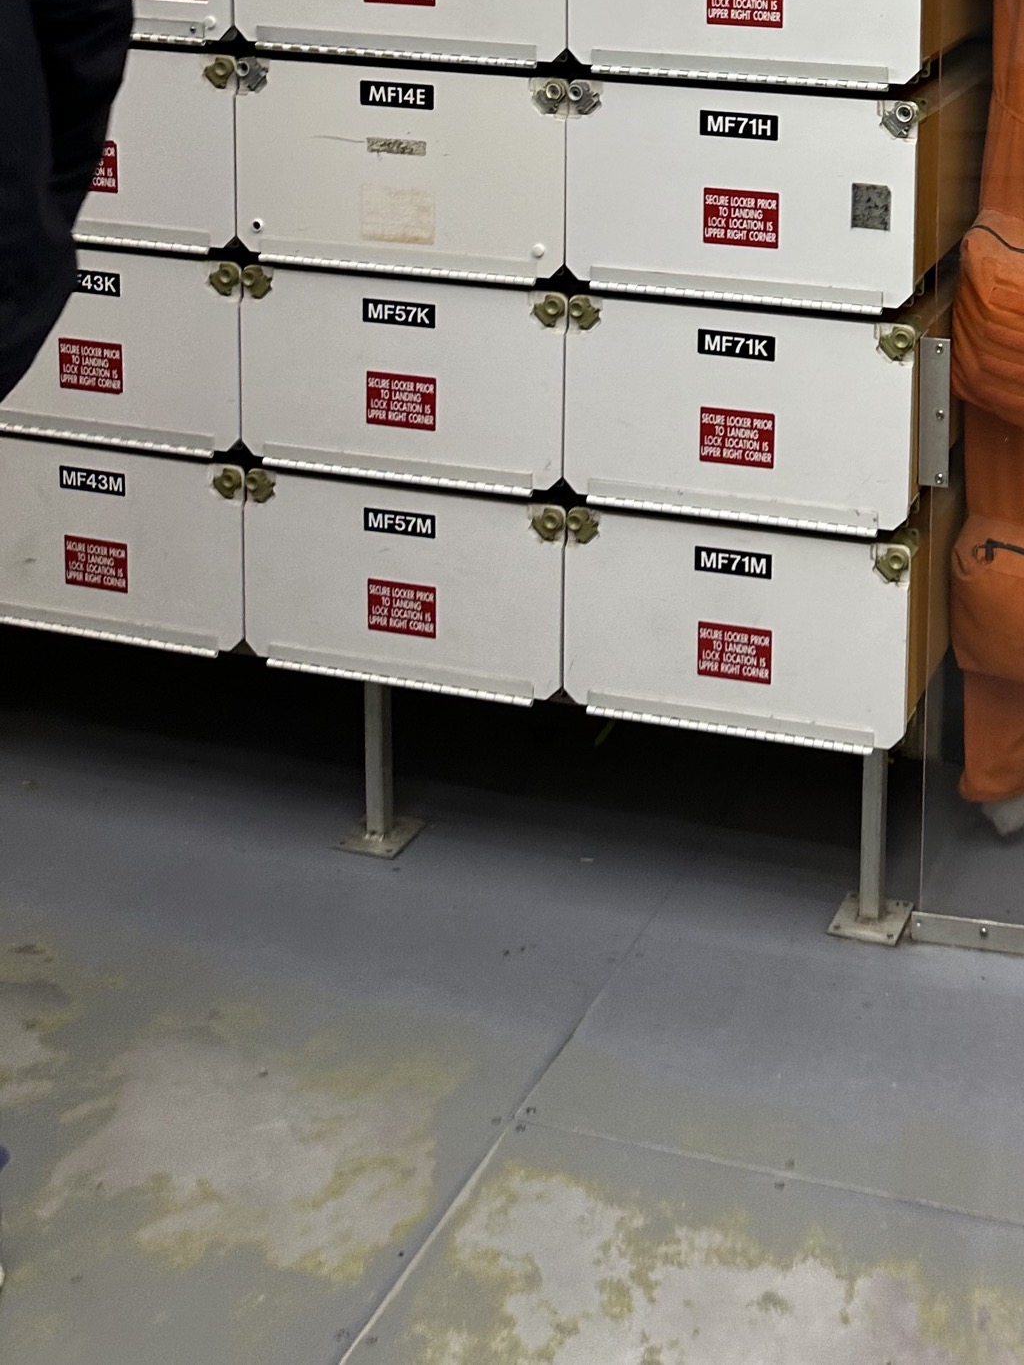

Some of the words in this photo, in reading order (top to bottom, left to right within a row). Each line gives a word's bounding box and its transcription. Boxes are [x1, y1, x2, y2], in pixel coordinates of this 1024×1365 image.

[770, 0, 777, 10] IS
[708, 8, 728, 18] UPPER
[730, 9, 751, 20] RIGHT
[753, 10, 780, 21] CORNER
[368, 85, 426, 105] MF14E
[707, 115, 772, 137] MF71H
[705, 194, 728, 205] SECURE
[730, 196, 755, 207] LOCKER
[757, 198, 776, 209] PRIOR
[718, 206, 728, 216] TO
[731, 207, 762, 219] LANDING
[707, 216, 726, 227] LOCK
[729, 218, 764, 230] LOCATION
[766, 221, 773, 231] IS
[704, 227, 724, 238] UPPER
[727, 229, 747, 240] RIGHT
[749, 231, 776, 242] CORNER
[368, 302, 430, 324] MF57K
[704, 334, 768, 357] MF71K
[701, 413, 725, 425] SECURE
[726, 415, 751, 427] LOCKER
[752, 418, 772, 430] PRIOR
[714, 425, 724, 435] TO
[727, 426, 758, 439] LANDING
[704, 435, 722, 446] LOCK
[725, 437, 759, 450] LOCATION
[762, 441, 768, 451] IS
[700, 445, 720, 457] UPPER
[722, 448, 742, 459] RIGHT
[744, 450, 771, 462] CORNER
[62, 470, 123, 492] MF43M
[368, 512, 432, 534] MF57M
[700, 550, 767, 575] MF71M
